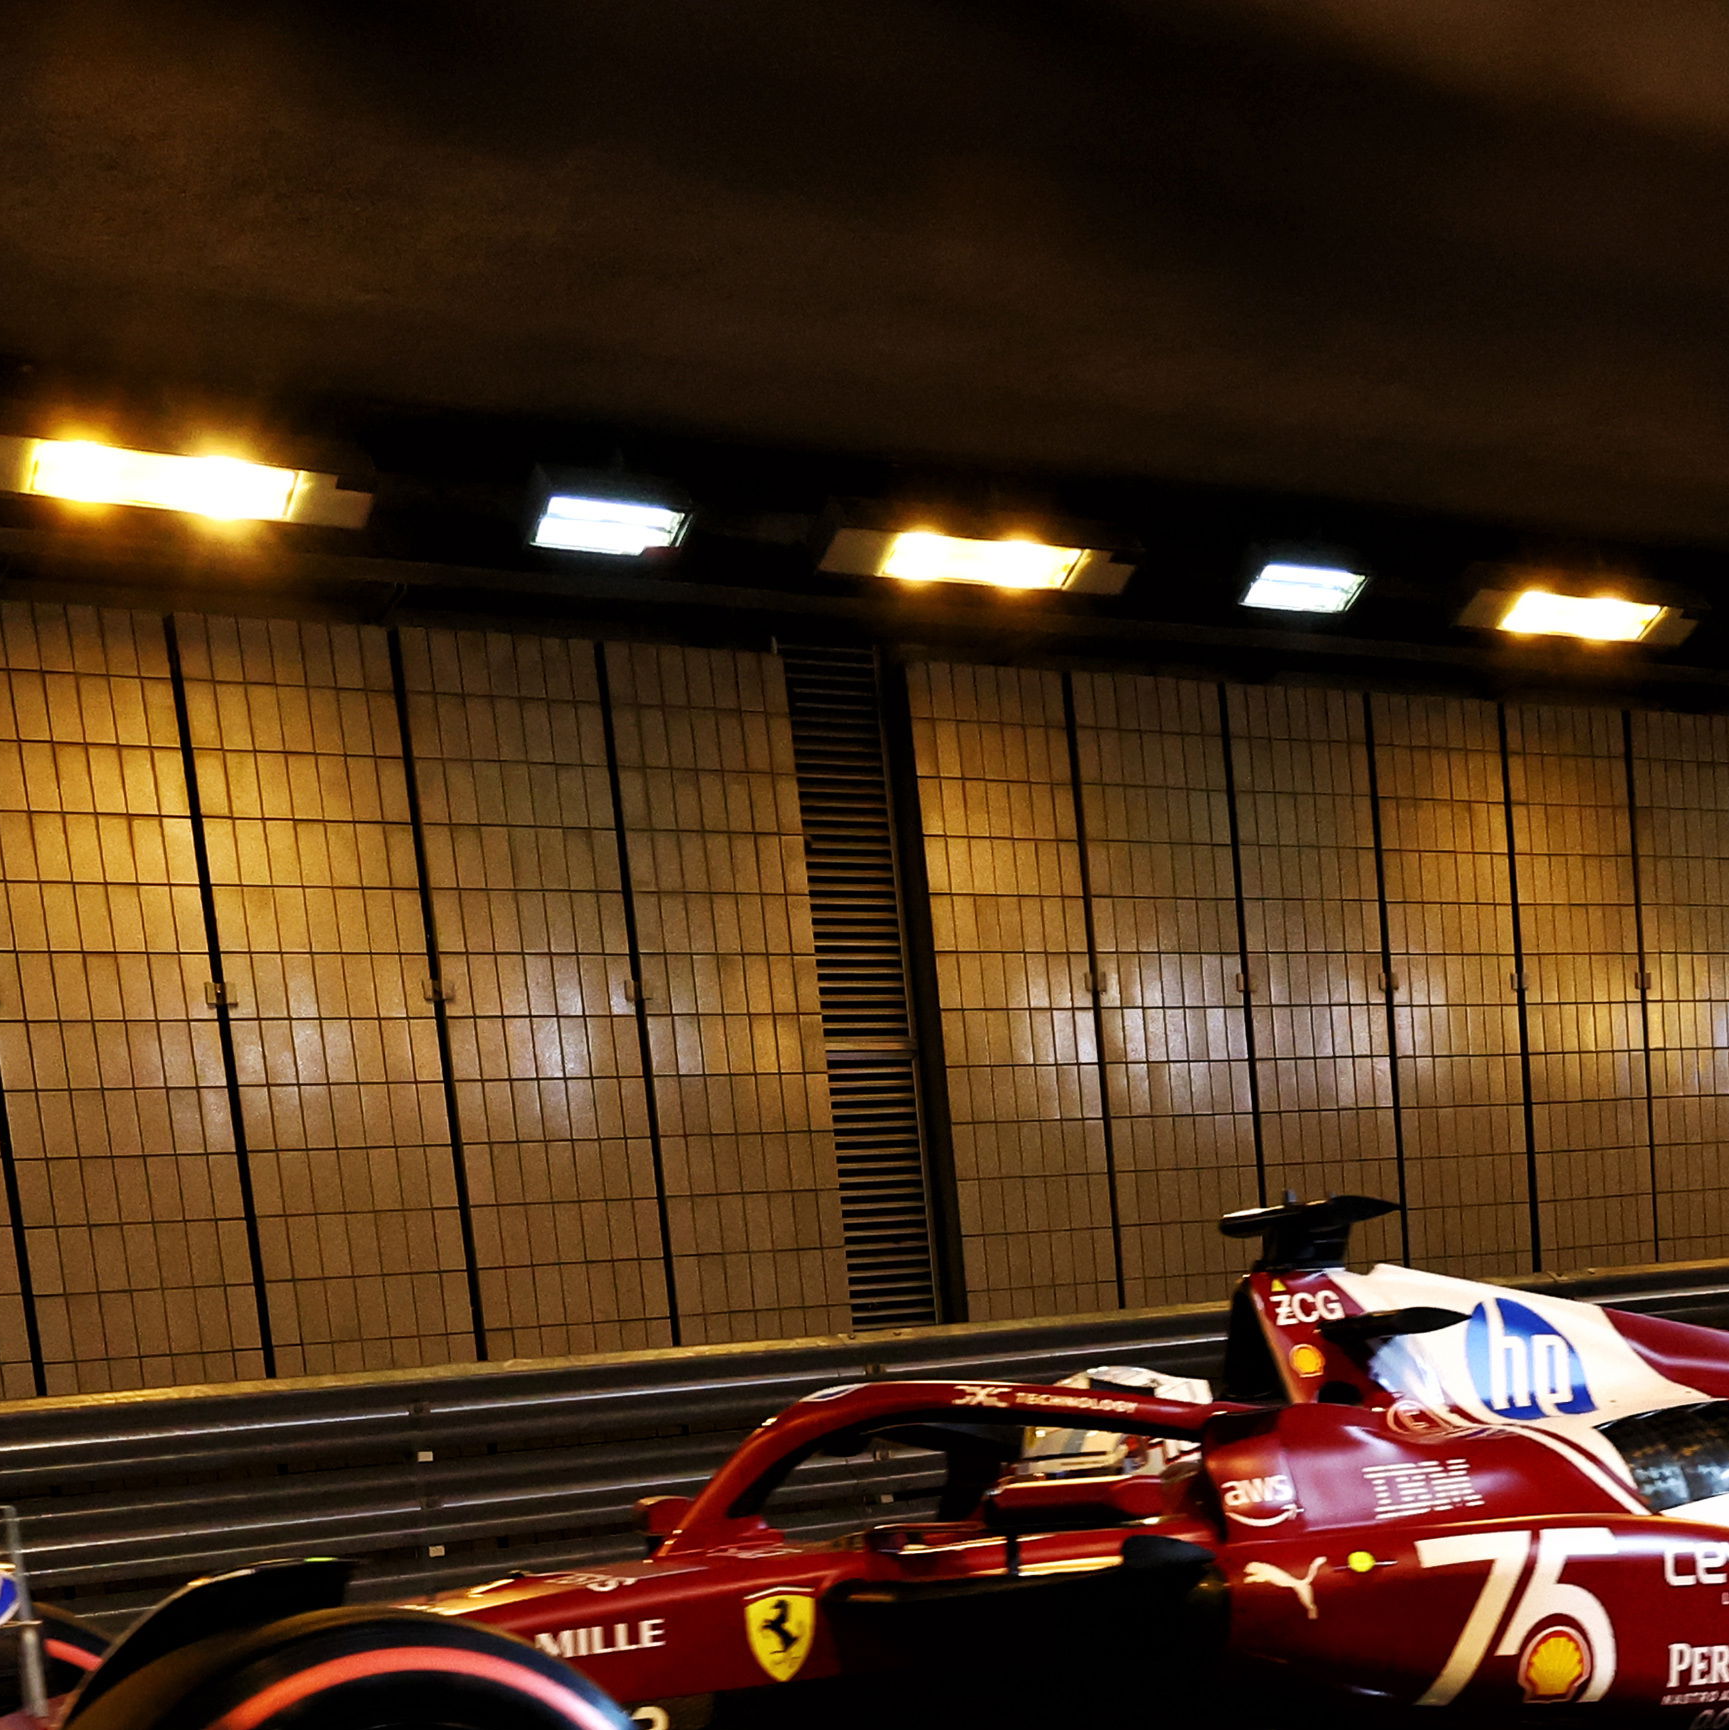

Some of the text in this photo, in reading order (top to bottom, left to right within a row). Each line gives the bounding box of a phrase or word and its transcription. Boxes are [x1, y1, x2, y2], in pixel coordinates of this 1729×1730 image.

[1269, 1290, 1345, 1327] ZCG
[1483, 1298, 1575, 1418] hp
[1015, 1392, 1138, 1414] TECHNOLOGY
[1221, 1474, 1295, 1506] aws
[1362, 1458, 1485, 1520] IBM
[1412, 1526, 1619, 1707] 75
[535, 1618, 667, 1659] MILLE
